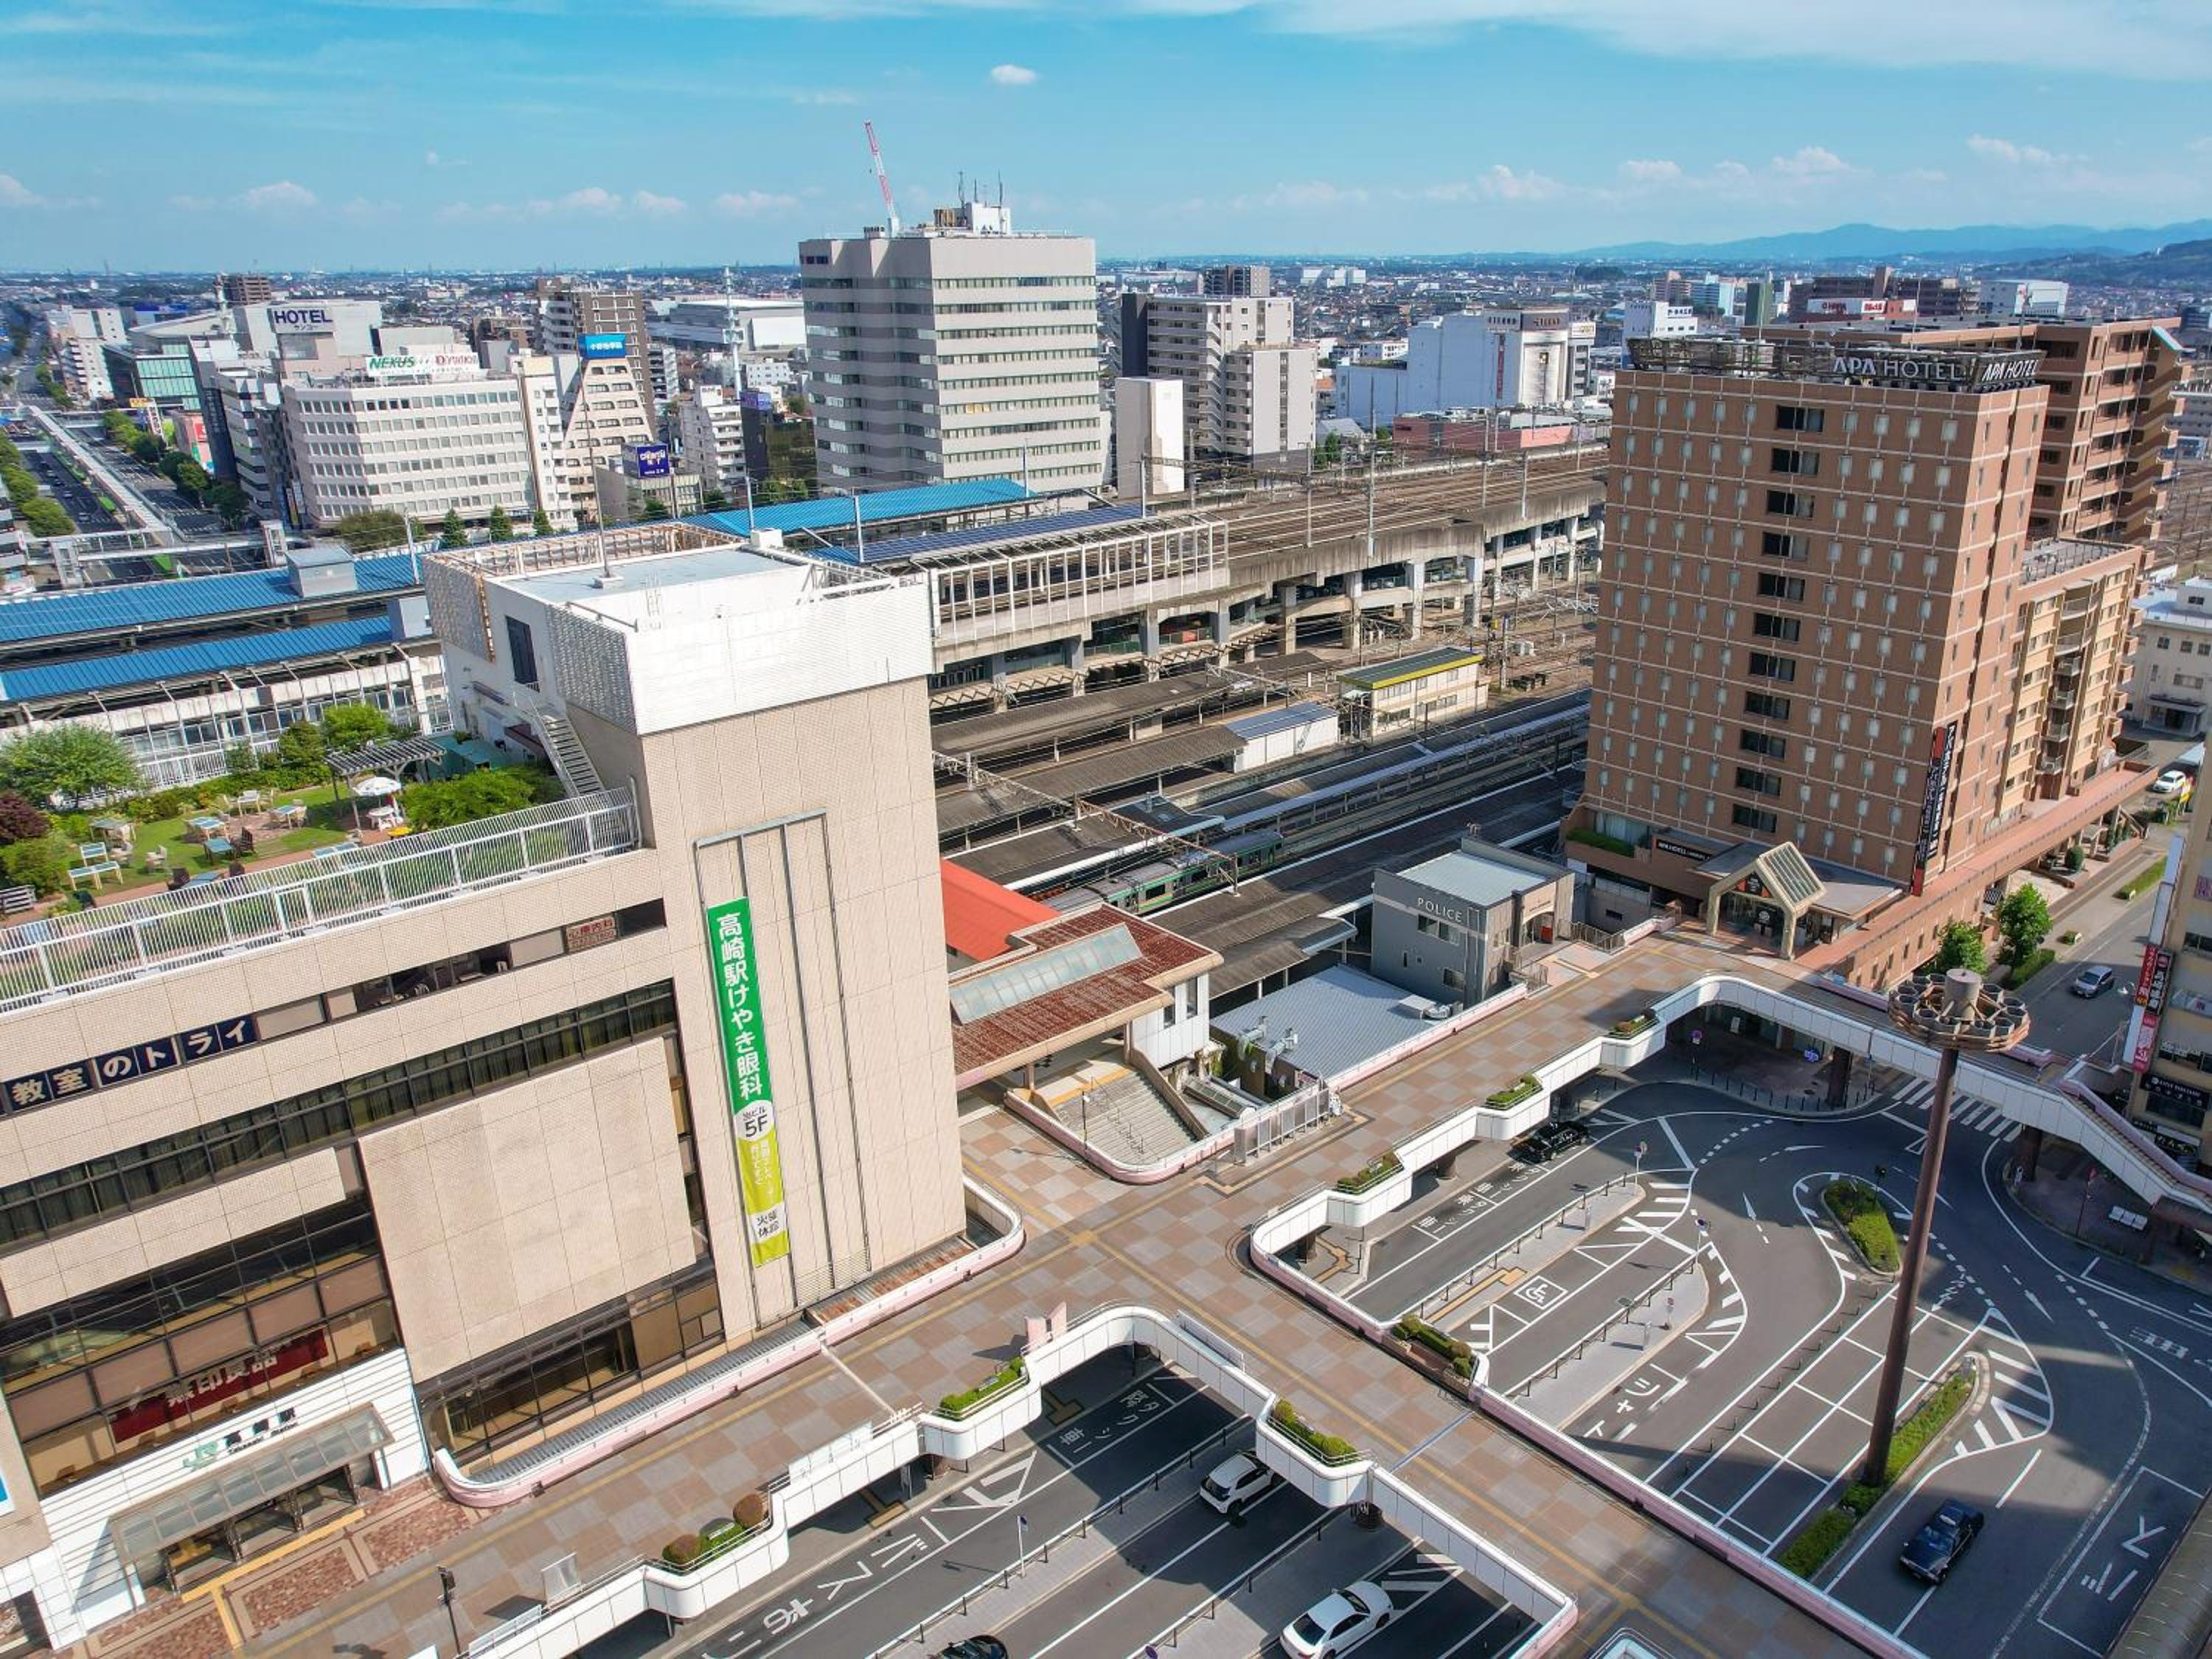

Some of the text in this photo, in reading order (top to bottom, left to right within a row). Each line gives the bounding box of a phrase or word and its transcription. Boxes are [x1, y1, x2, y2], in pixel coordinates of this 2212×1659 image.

[274, 310, 333, 323] HOTEL
[369, 356, 415, 369] NEXUS
[1833, 357, 1962, 380] APA HOTEL
[1982, 359, 2040, 382] APA HOTEL
[1417, 897, 1463, 922] POLICE
[717, 912, 763, 1101] 高崎駅けやき眼科
[10, 1018, 253, 1108] 教室のトライ
[745, 1115, 768, 1138] 5F
